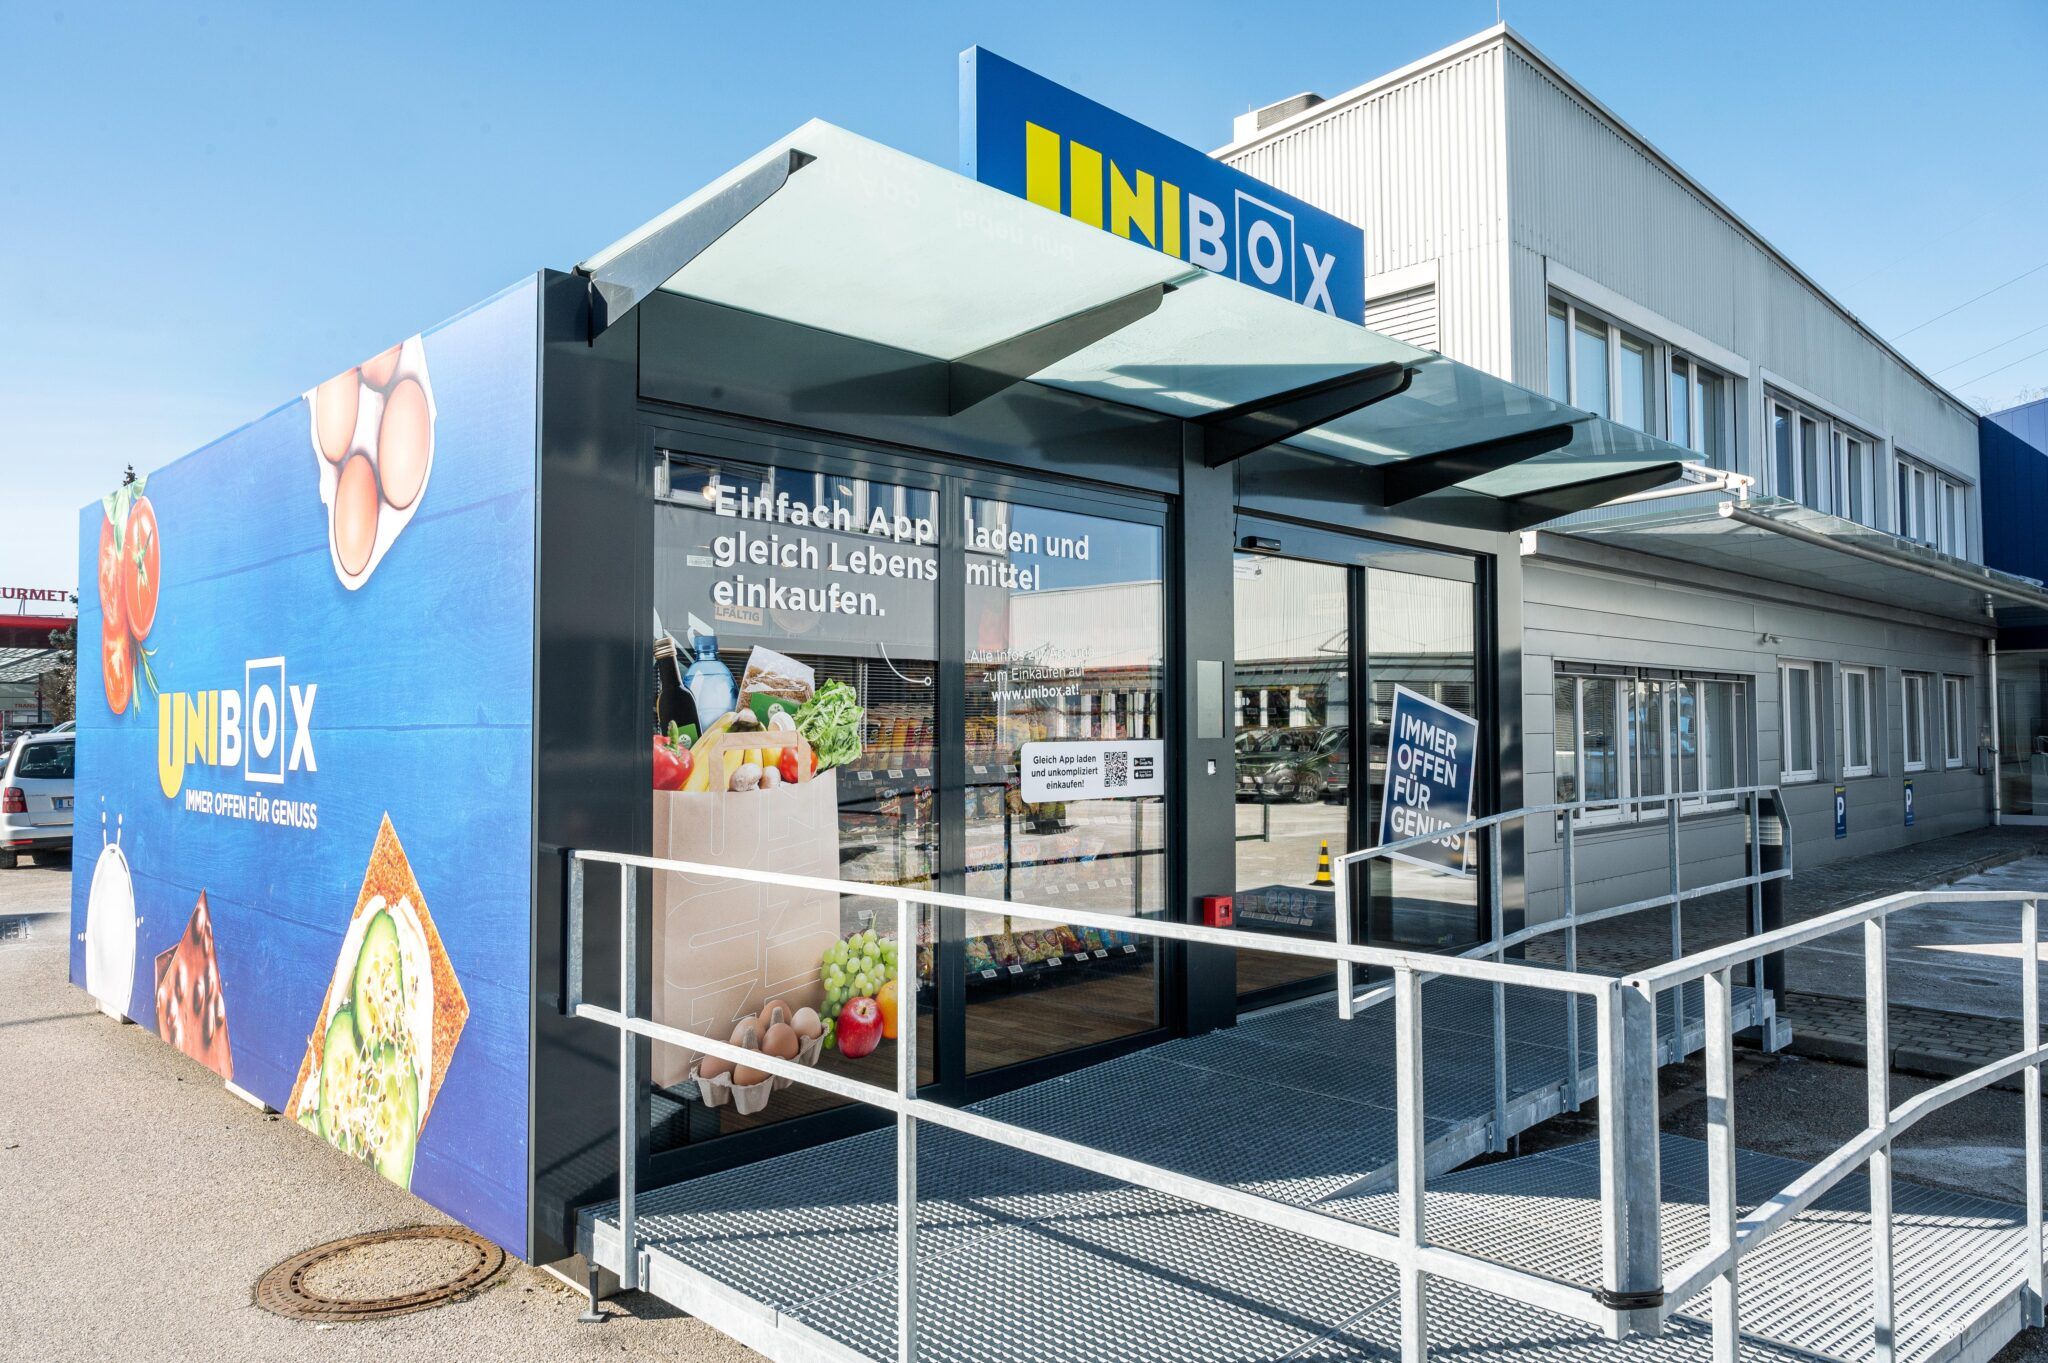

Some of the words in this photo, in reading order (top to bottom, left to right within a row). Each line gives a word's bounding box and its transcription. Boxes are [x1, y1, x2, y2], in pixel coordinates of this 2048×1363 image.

[715, 484, 850, 531] Einfach
[868, 506, 932, 545] App
[968, 518, 1038, 554] laden
[1046, 535, 1089, 560] und
[713, 530, 818, 570] gleich
[831, 542, 938, 581] Lebens
[966, 560, 1039, 591] mittel
[0, 587, 69, 602] URMET
[713, 574, 886, 617] einkaufen.
[715, 605, 760, 622] LFÄLTIG
[970, 650, 993, 663] Alle
[996, 649, 1025, 662] Infos
[982, 670, 1008, 683] zum
[1011, 665, 1066, 681] Einkaufen
[991, 683, 1080, 702] www.unibox.at!
[158, 683, 318, 799] UNIBOX
[1400, 713, 1457, 760] IMMER
[1033, 755, 1057, 765] Gleich
[1059, 755, 1074, 765] App
[1076, 754, 1096, 764] laden
[1397, 743, 1457, 788] OFFEN
[1031, 768, 1046, 777] und
[1048, 767, 1098, 779] unkompliziert
[1046, 780, 1085, 790] einkaufen!
[1393, 773, 1431, 812] FÜR
[1906, 788, 1912, 813] P
[185, 788, 213, 814] IMMER
[214, 792, 247, 819] OFFEN
[249, 791, 270, 823] FÜR
[271, 799, 318, 830] GENUSS
[1837, 796, 1845, 824] P
